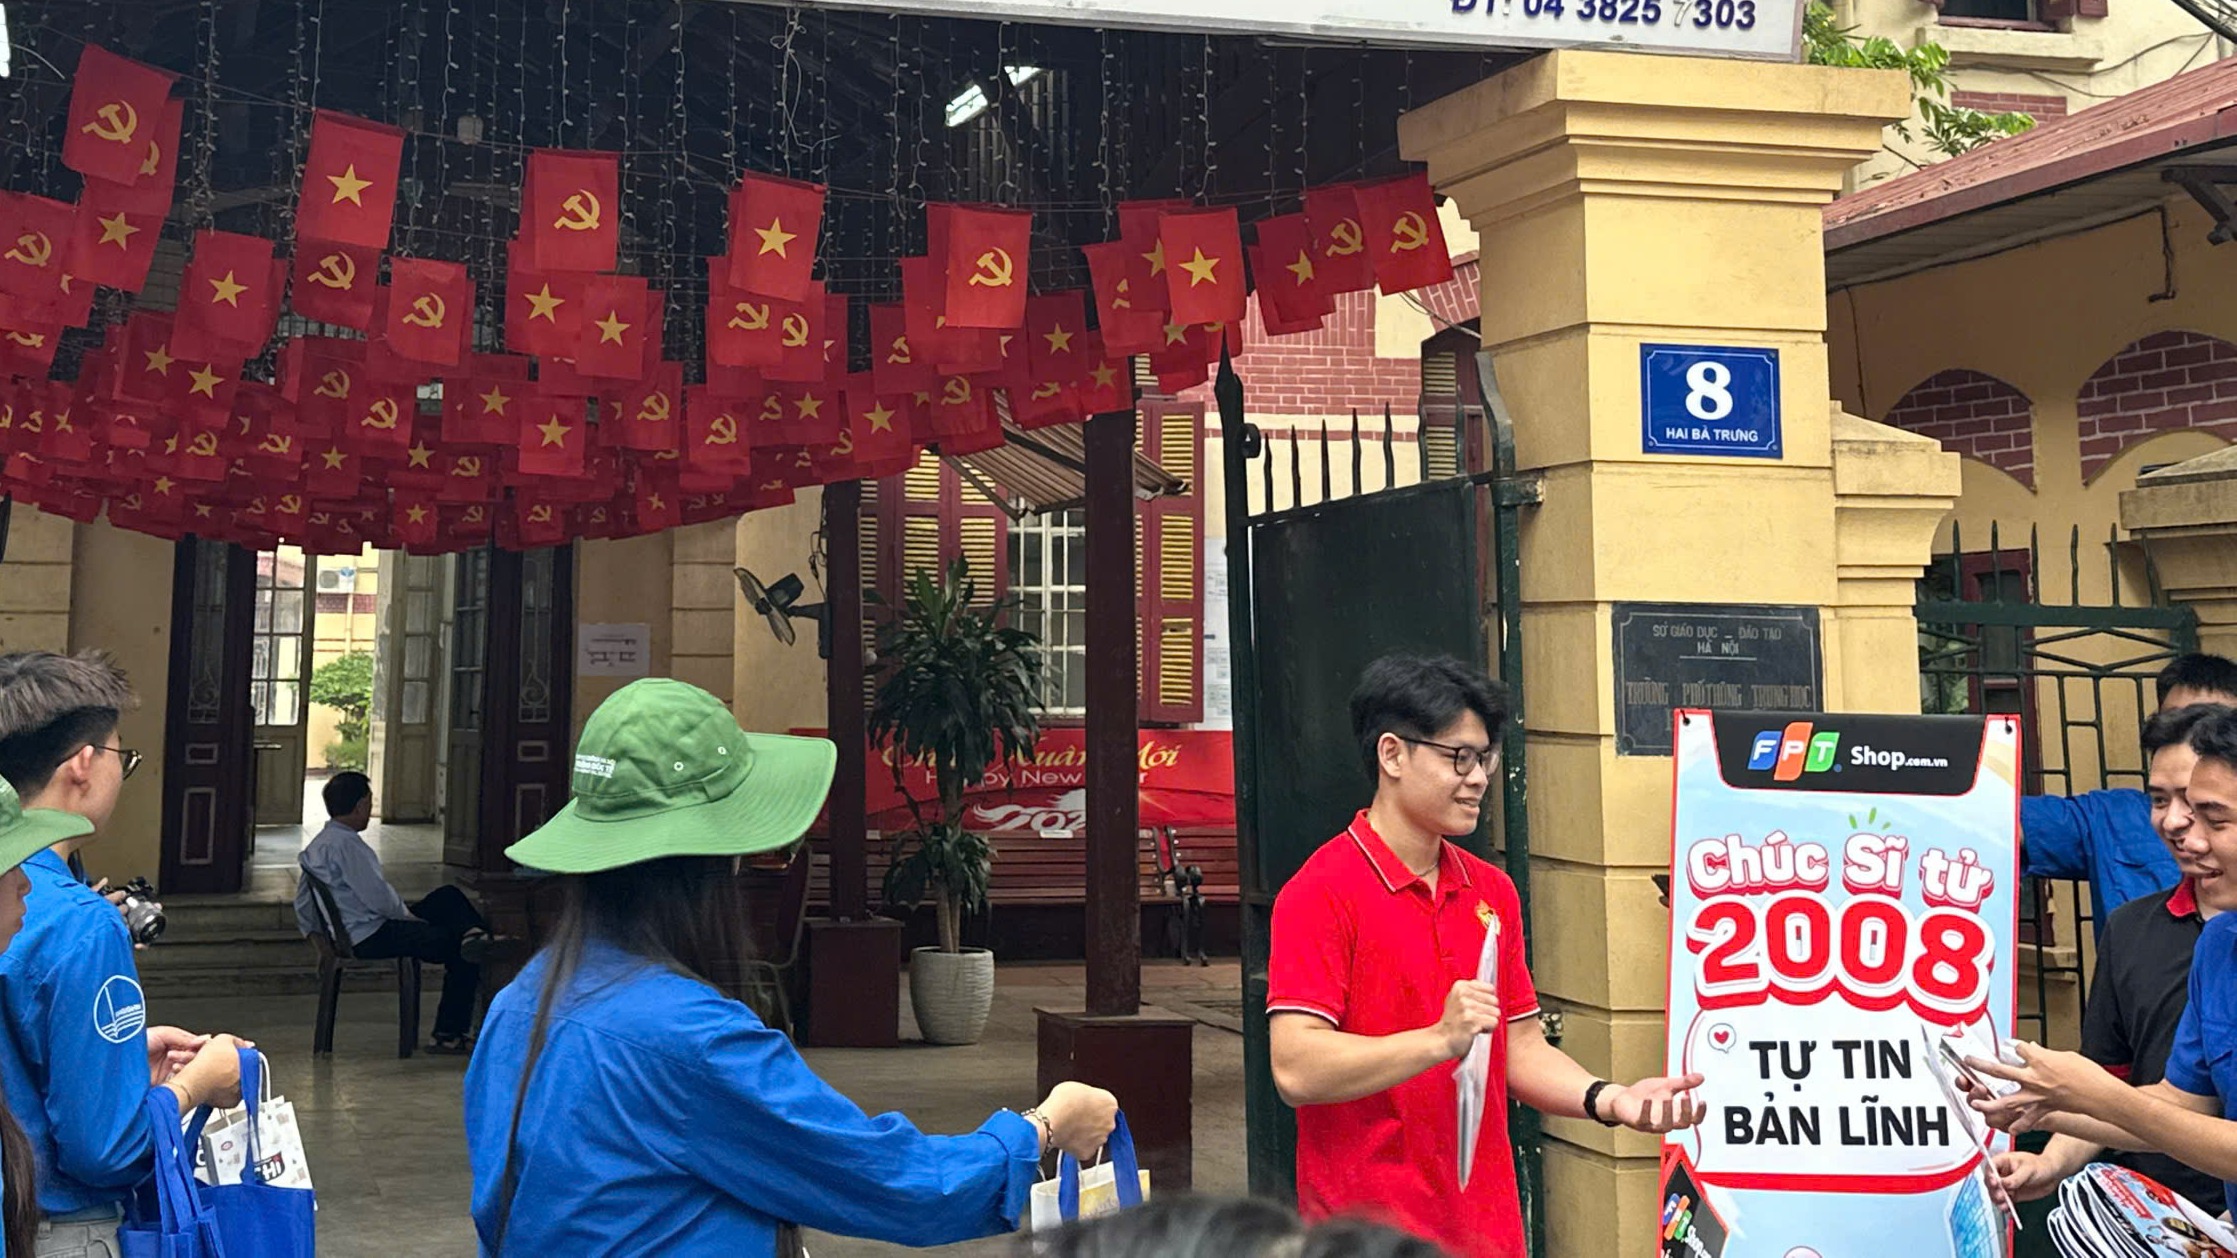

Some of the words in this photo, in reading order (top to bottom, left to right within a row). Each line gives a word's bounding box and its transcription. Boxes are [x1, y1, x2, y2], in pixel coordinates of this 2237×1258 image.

[1576, 0, 1661, 25] 3825
[1673, 0, 1756, 30] 7303
[1685, 361, 1733, 420] 8
[1666, 427, 1688, 439] HAI
[1713, 428, 1758, 442] TRƯNG
[1021, 769, 1083, 785] New
[1687, 830, 1829, 892] Chúc
[1843, 832, 1908, 892] Sĩ
[1920, 848, 1994, 908] tử
[1690, 893, 1991, 1012] 2008
[1749, 1040, 1817, 1092] TỰ
[1832, 1040, 1912, 1079] TIN
[1724, 1091, 1821, 1145] BẢN
[1839, 1095, 1950, 1146] LĨNH
